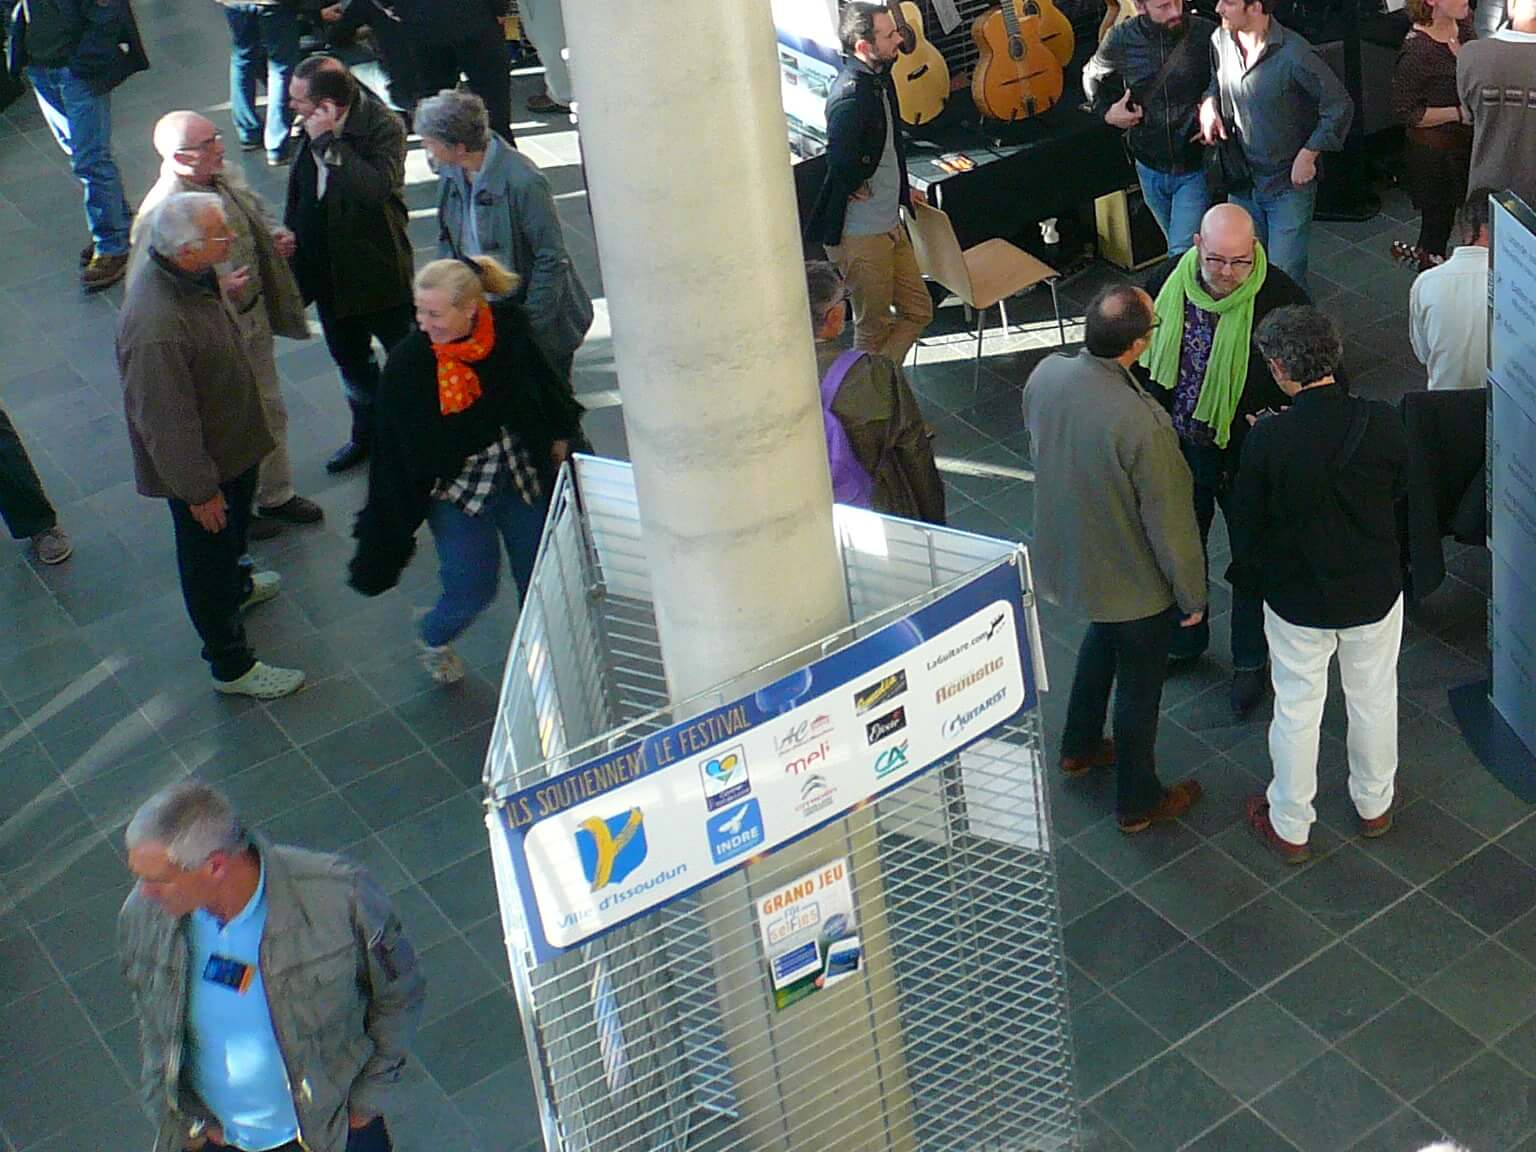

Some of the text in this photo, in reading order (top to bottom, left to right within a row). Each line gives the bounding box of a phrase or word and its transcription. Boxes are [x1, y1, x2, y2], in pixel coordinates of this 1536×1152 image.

[506, 796, 534, 830] ILS
[536, 738, 649, 817] SOUTIENNENT
[653, 734, 678, 767] LE
[679, 705, 751, 756] FESTIVAL
[715, 825, 760, 856] INDRE
[598, 862, 688, 912] d'Issoudun
[762, 864, 844, 915] GRAND JEU
